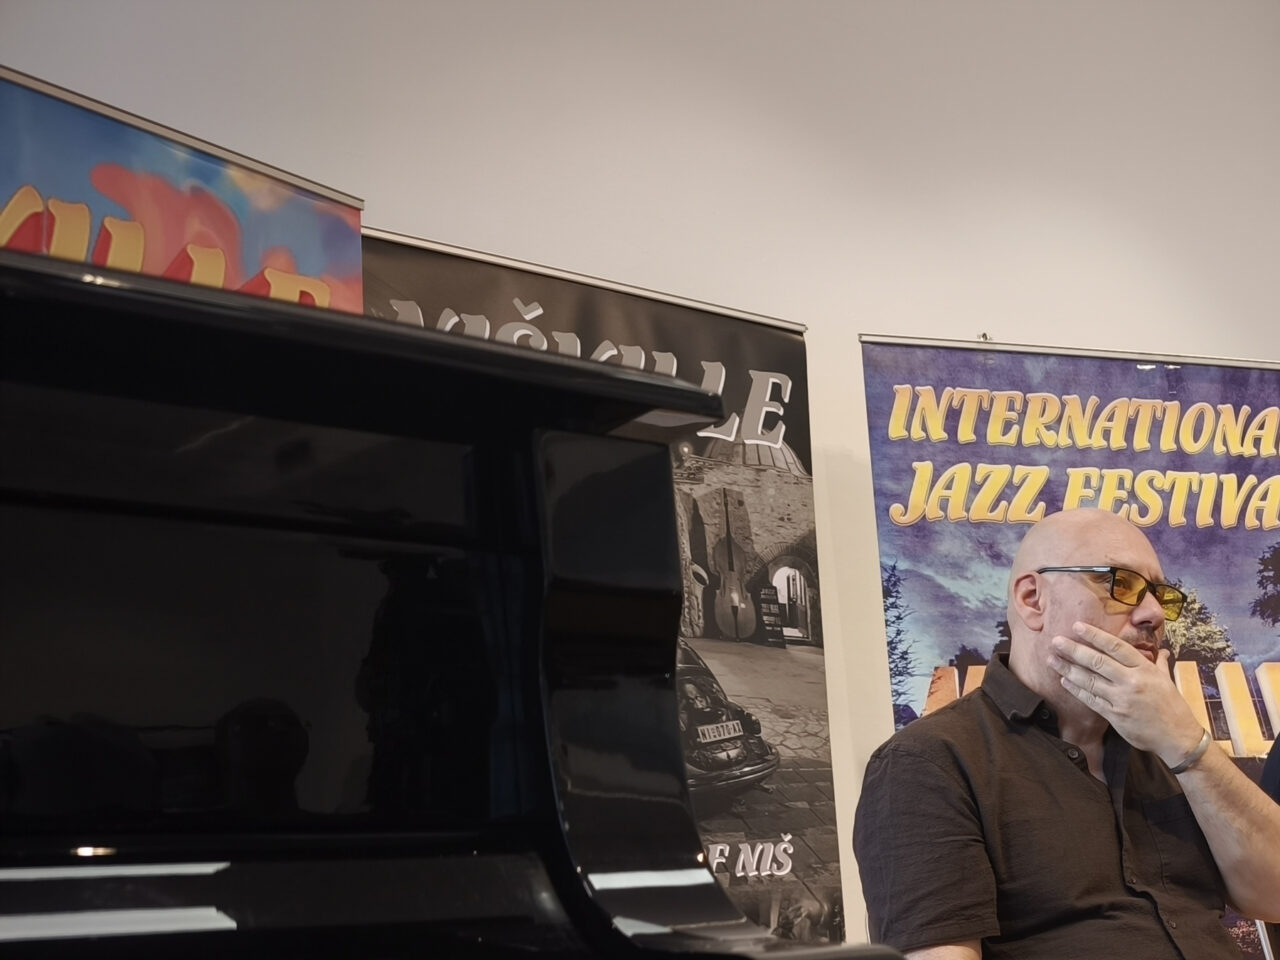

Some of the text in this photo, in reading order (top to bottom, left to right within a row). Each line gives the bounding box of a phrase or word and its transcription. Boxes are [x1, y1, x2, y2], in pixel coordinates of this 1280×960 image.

[890, 461, 1050, 526] JAZZ
[708, 833, 794, 877] F NIŠ
